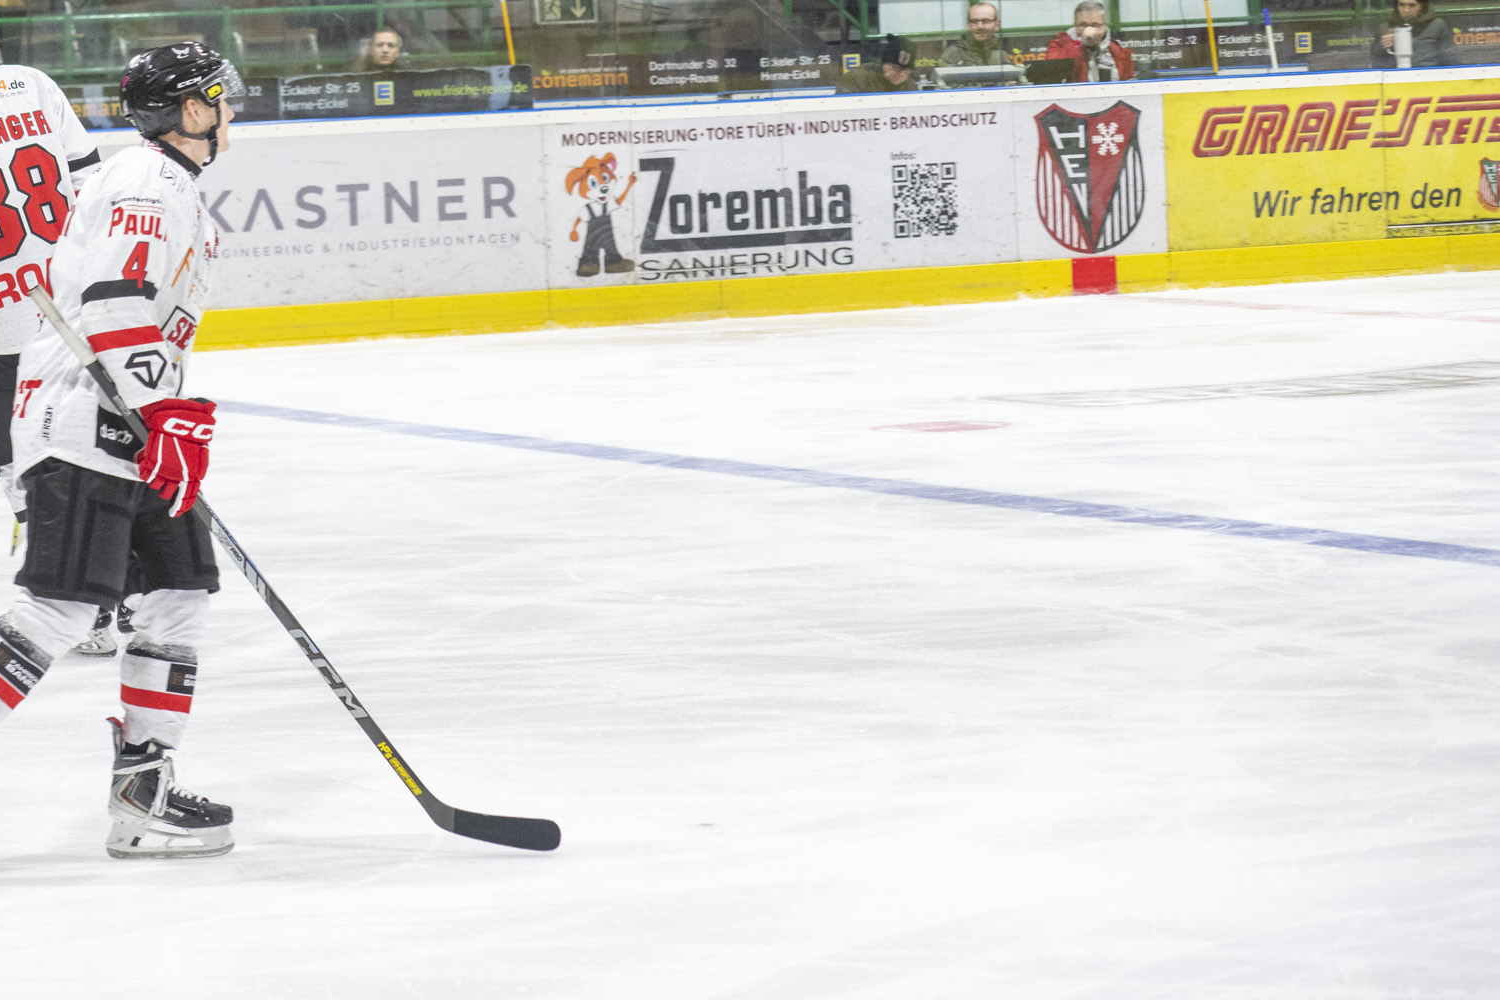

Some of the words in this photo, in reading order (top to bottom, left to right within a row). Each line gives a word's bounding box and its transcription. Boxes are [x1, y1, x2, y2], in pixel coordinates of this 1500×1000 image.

[177, 76, 203, 89] CCM
[348, 81, 361, 93] 25
[561, 128, 698, 147] MODERNISIERUNG
[706, 126, 744, 141] TORE
[748, 121, 796, 138] TÜREN
[804, 117, 881, 135] INDUSTRIE
[889, 111, 998, 130] BRANDSCHUTZ
[1192, 96, 1434, 158] GRAF'S
[200, 176, 518, 234] KASTNER
[638, 157, 853, 255] Zoremba
[1254, 190, 1301, 219] Wir
[1310, 186, 1400, 215] fahren
[1411, 181, 1462, 210] den
[339, 232, 521, 252] INDUSTRIEMONTAGEN
[121, 240, 151, 290] 4
[638, 247, 855, 281] SANIERUNG
[288, 627, 370, 719] CCM
